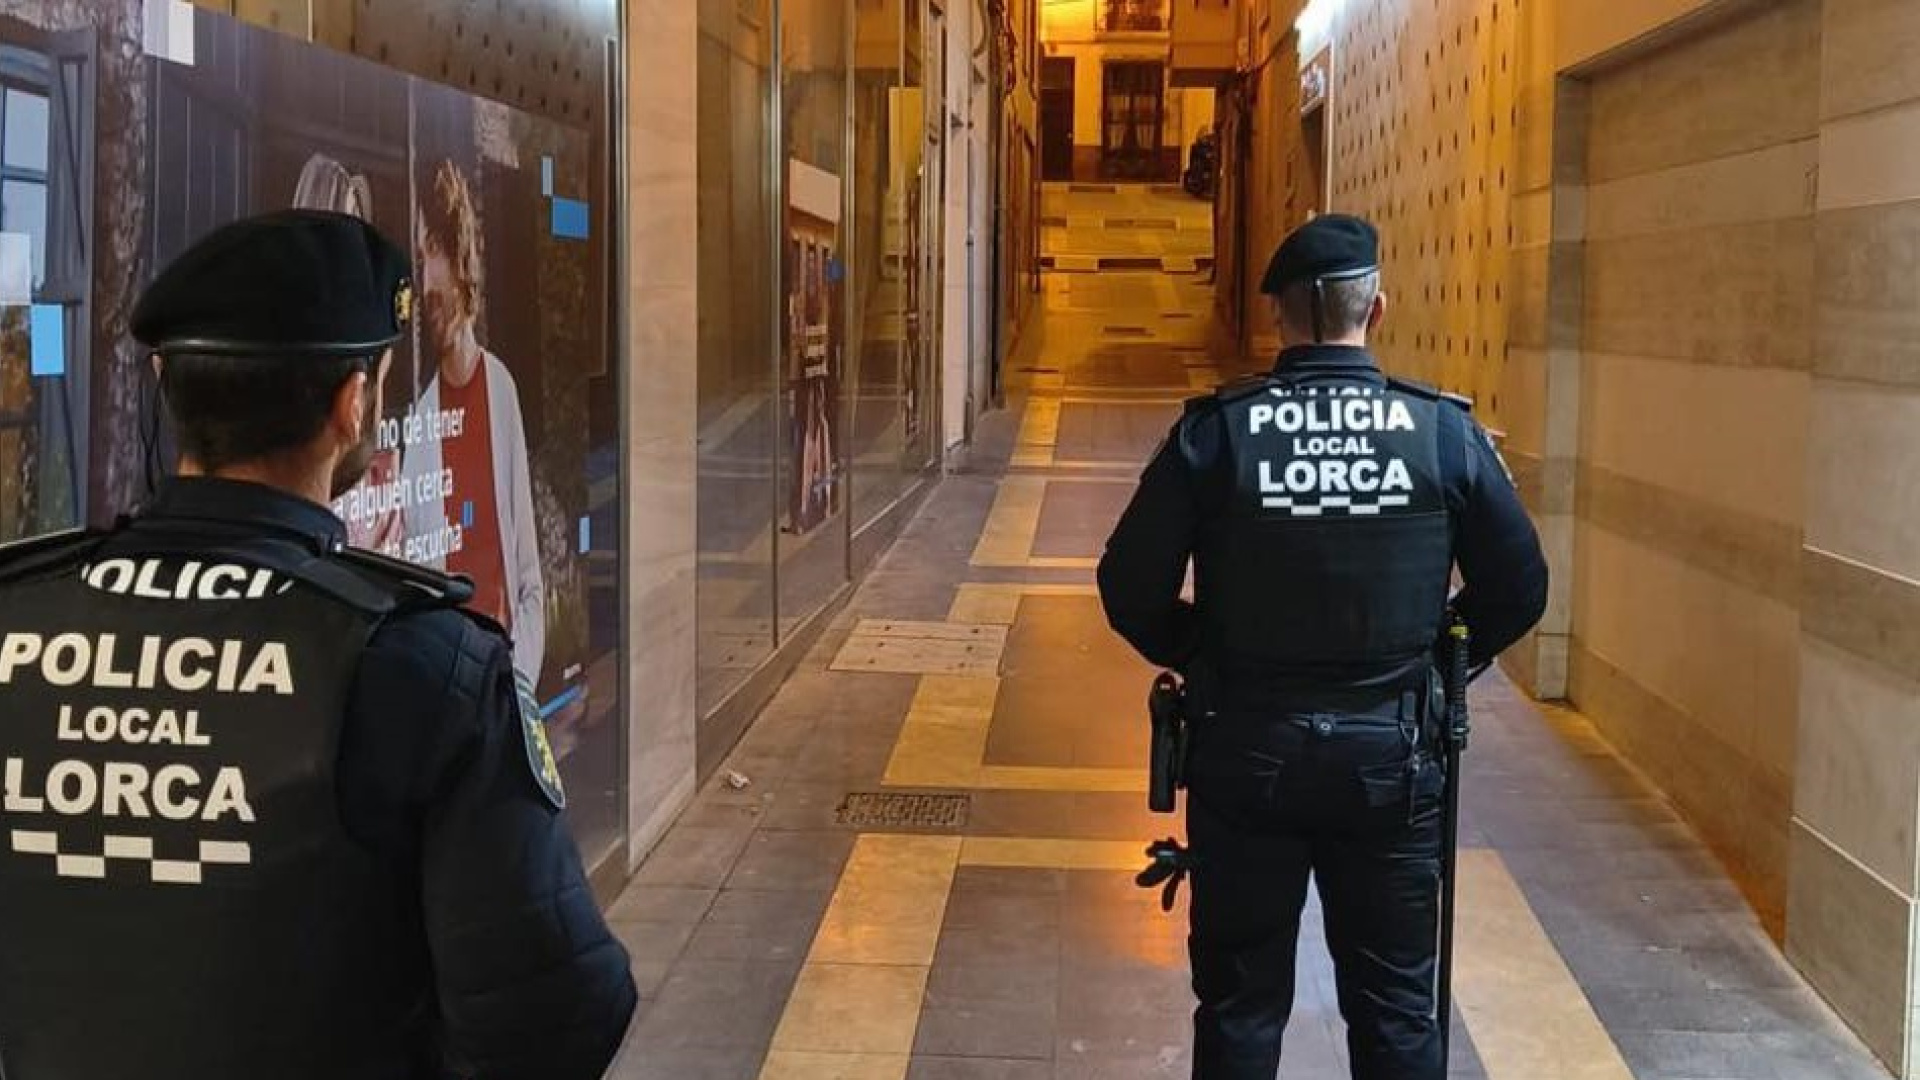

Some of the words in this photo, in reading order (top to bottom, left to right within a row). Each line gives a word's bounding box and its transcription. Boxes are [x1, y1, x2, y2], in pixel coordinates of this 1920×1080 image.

[403, 403, 423, 444] de
[428, 405, 465, 442] tener
[1250, 398, 1415, 434] POLICIA
[1293, 437, 1375, 456] LOCAL
[1259, 458, 1414, 492] LORCA
[350, 470, 412, 529] alguien
[416, 468, 453, 506] cerca
[405, 516, 463, 563] escucha
[81, 558, 295, 600] OLICI
[0, 632, 295, 694] POLICIA
[57, 705, 212, 745] LOCAL
[4, 757, 257, 822] LORCA
